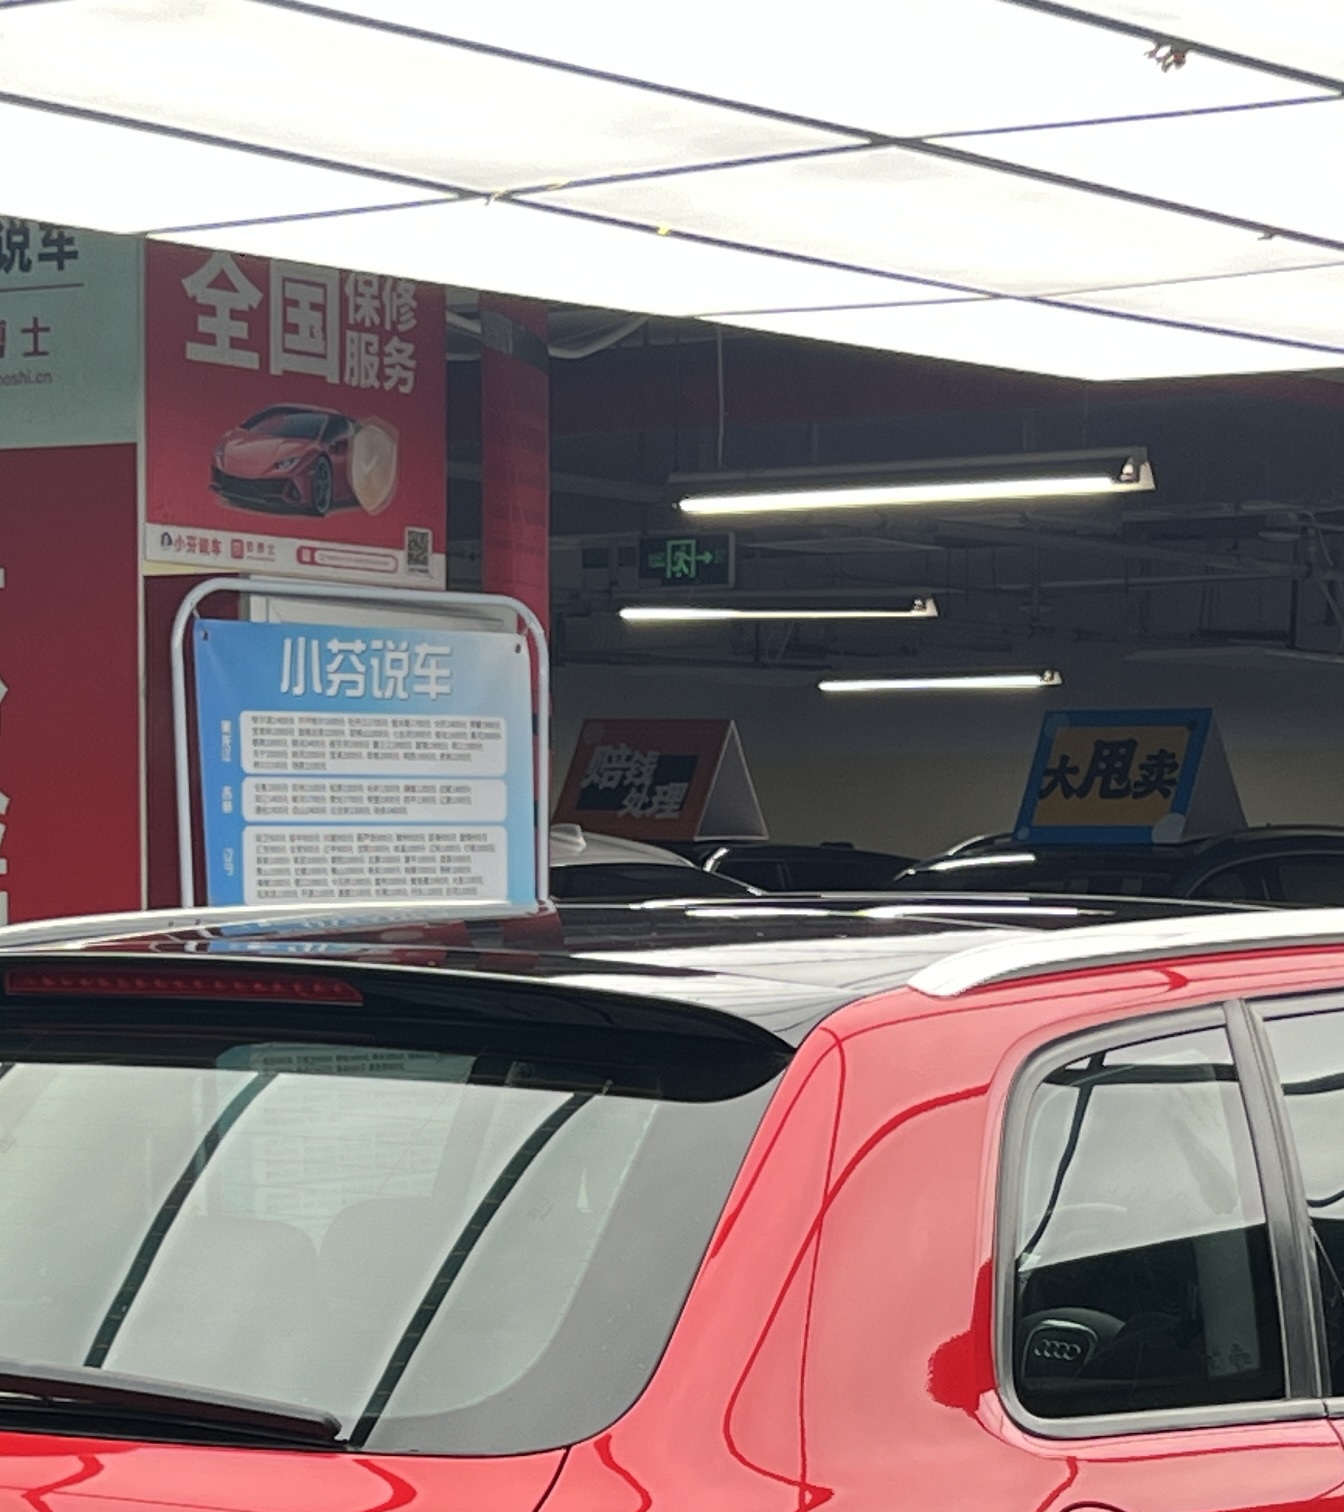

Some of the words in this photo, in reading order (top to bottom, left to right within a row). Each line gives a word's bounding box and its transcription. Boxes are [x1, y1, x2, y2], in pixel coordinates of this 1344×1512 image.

[181, 250, 341, 385] 全国
[344, 271, 418, 332] 保修
[343, 329, 418, 394] 服务
[279, 636, 452, 700] 小芬说车
[581, 741, 660, 790] 赔钱
[1038, 737, 1180, 800] 大甩卖
[616, 780, 689, 820] 处理
